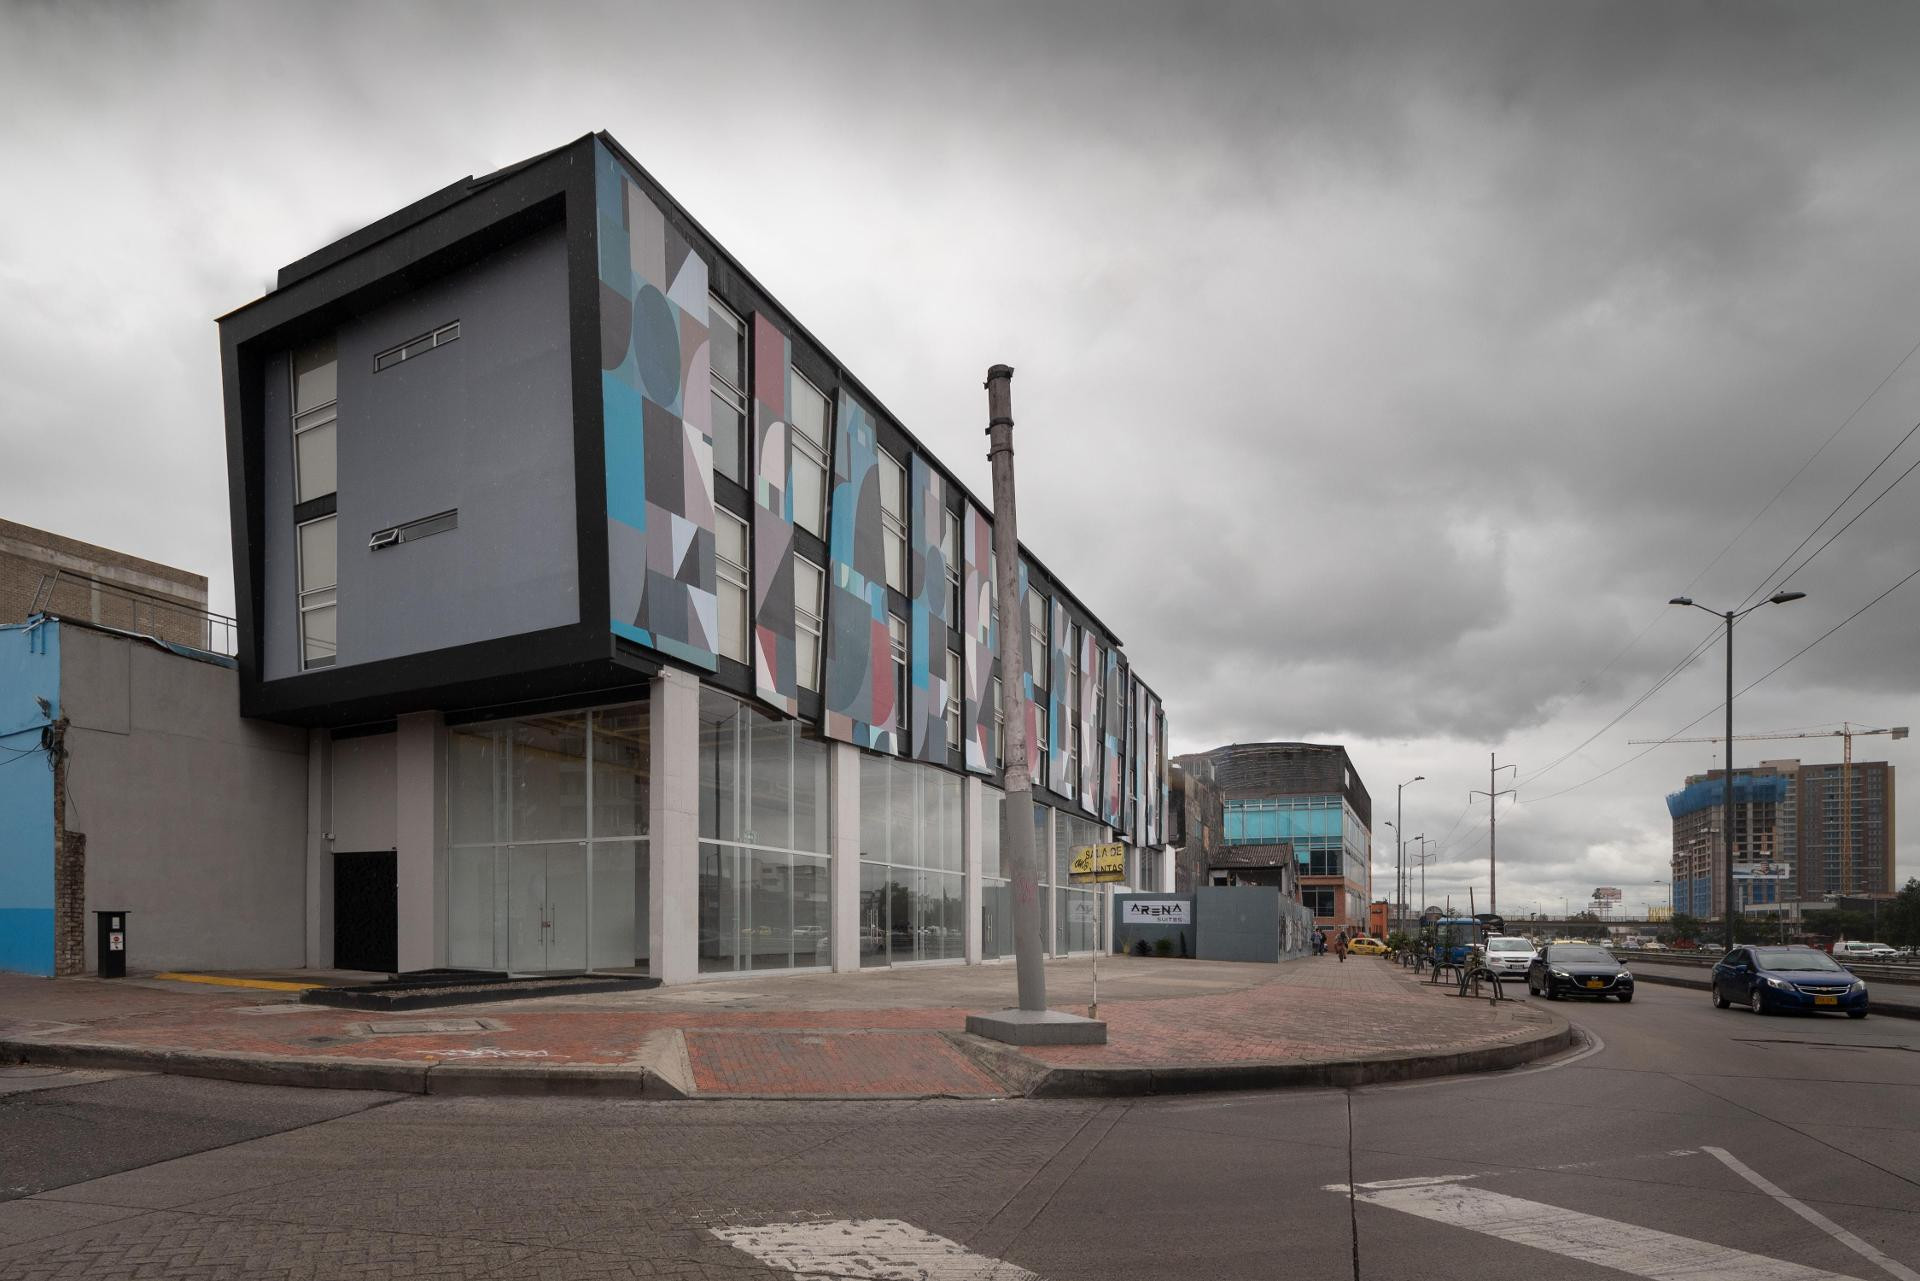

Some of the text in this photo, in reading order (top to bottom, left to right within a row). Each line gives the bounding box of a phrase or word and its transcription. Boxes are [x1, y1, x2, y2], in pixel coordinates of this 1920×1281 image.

[1110, 846, 1122, 857] DE
[1089, 863, 1124, 872] NTAS
[1131, 903, 1182, 916] ARENA
